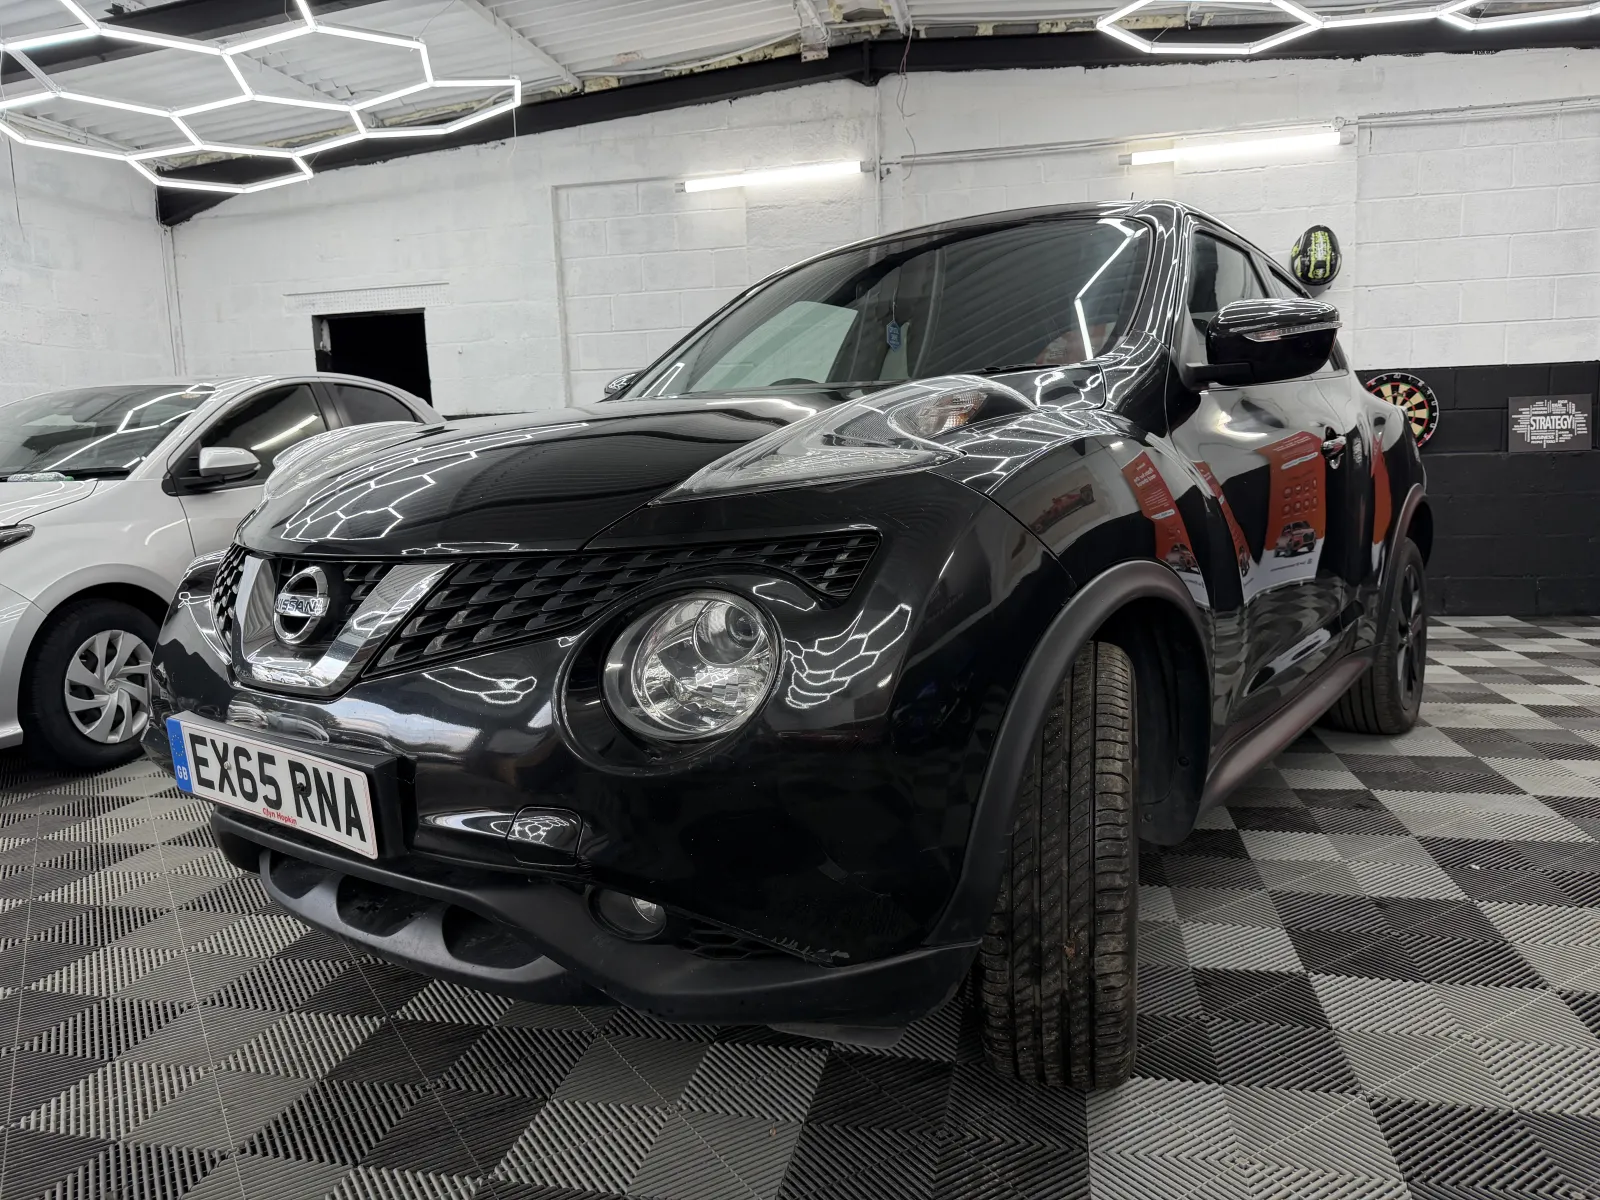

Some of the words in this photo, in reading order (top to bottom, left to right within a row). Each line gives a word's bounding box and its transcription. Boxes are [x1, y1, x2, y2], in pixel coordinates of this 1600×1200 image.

[1530, 415, 1573, 430] STRATEGY
[275, 598, 316, 614] NISSAN
[176, 764, 188, 781] GB
[189, 733, 283, 811] EX65
[288, 759, 366, 842] RNA
[277, 812, 298, 824] Hopkin
